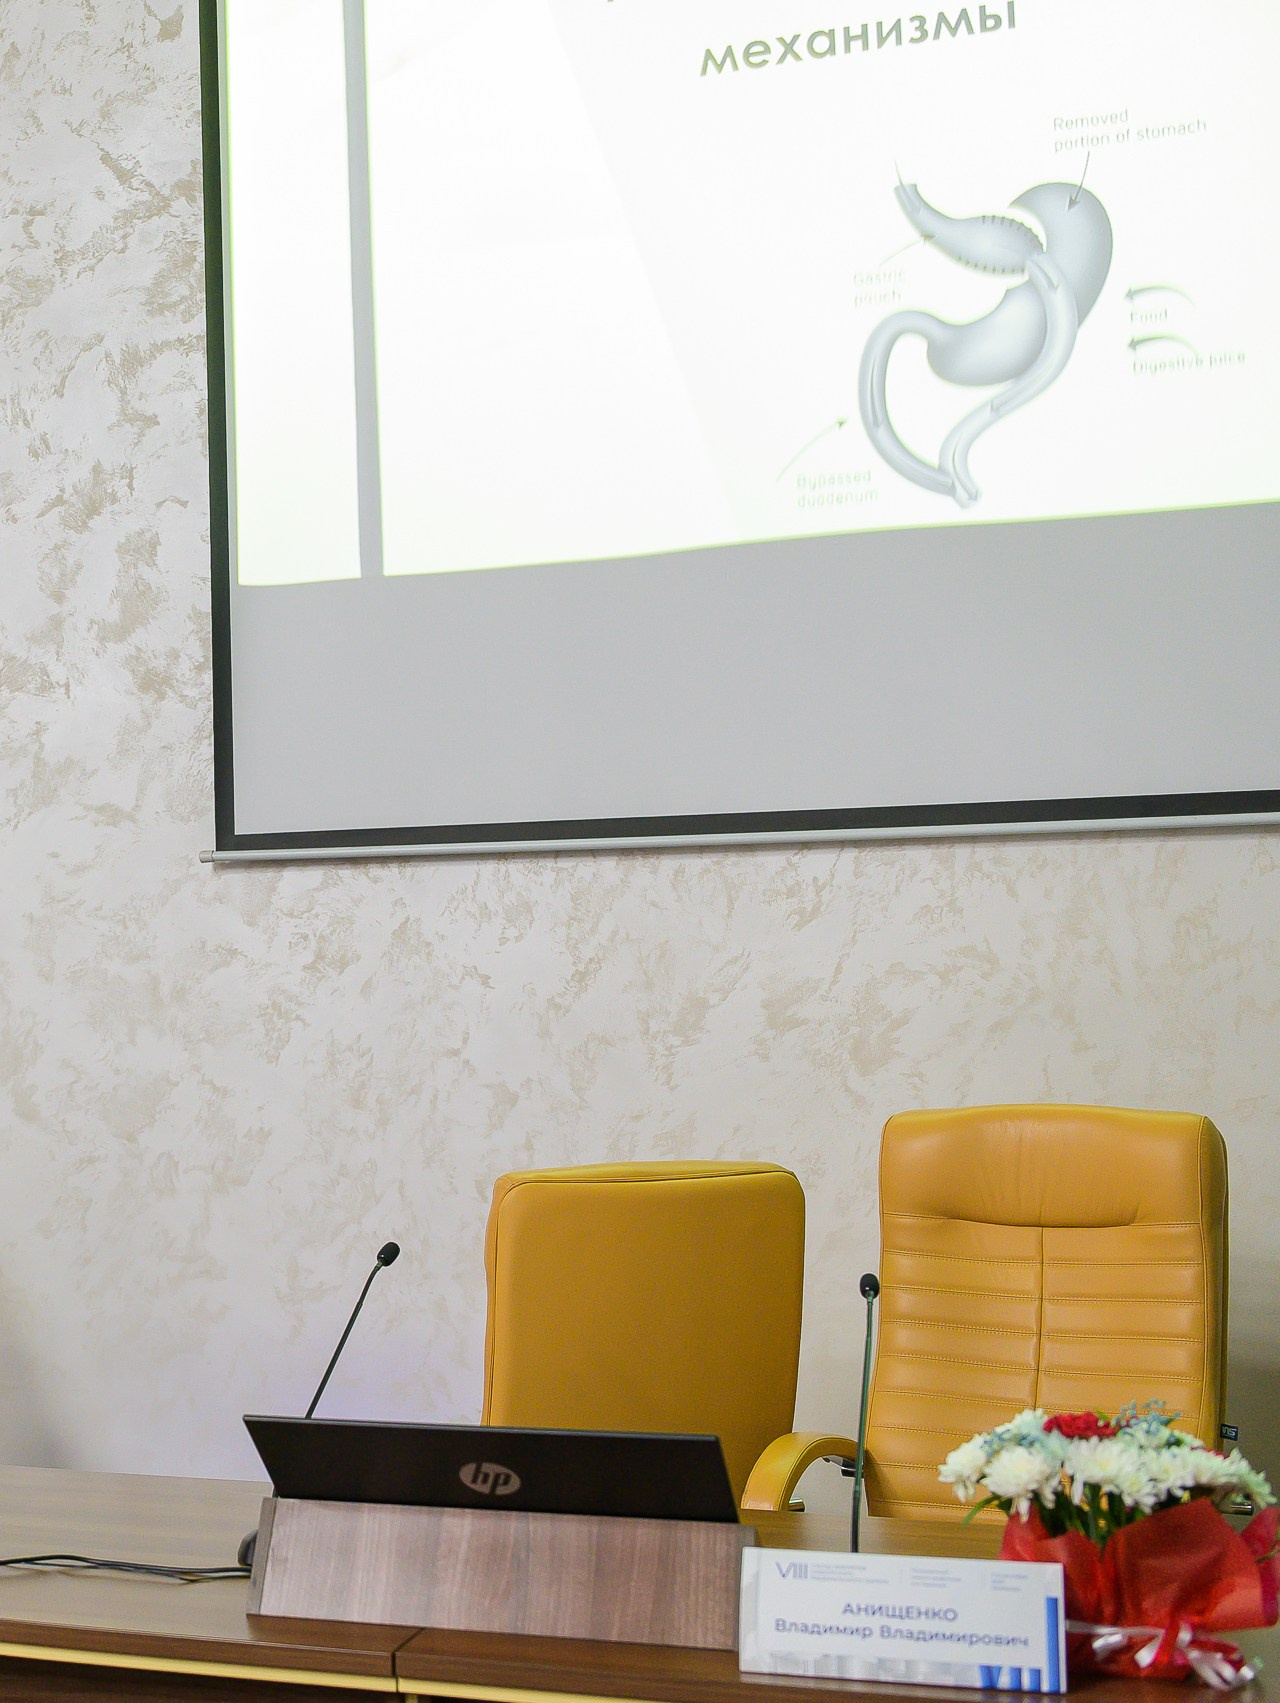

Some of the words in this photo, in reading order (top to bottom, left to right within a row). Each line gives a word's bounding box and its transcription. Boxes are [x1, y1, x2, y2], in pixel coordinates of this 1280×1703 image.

[700, 0, 1017, 77] механизмы
[1052, 108, 1129, 131] Removed
[1053, 133, 1110, 153] portion
[1116, 128, 1132, 144] of
[1136, 118, 1208, 142] stomach
[796, 468, 872, 491] Bypassed
[796, 488, 879, 509] duodenum
[463, 1462, 518, 1496] hp
[841, 1601, 959, 1623] АНИЩЕНКО
[774, 1617, 874, 1640] Владимир
[879, 1624, 1030, 1648] Владимирович
